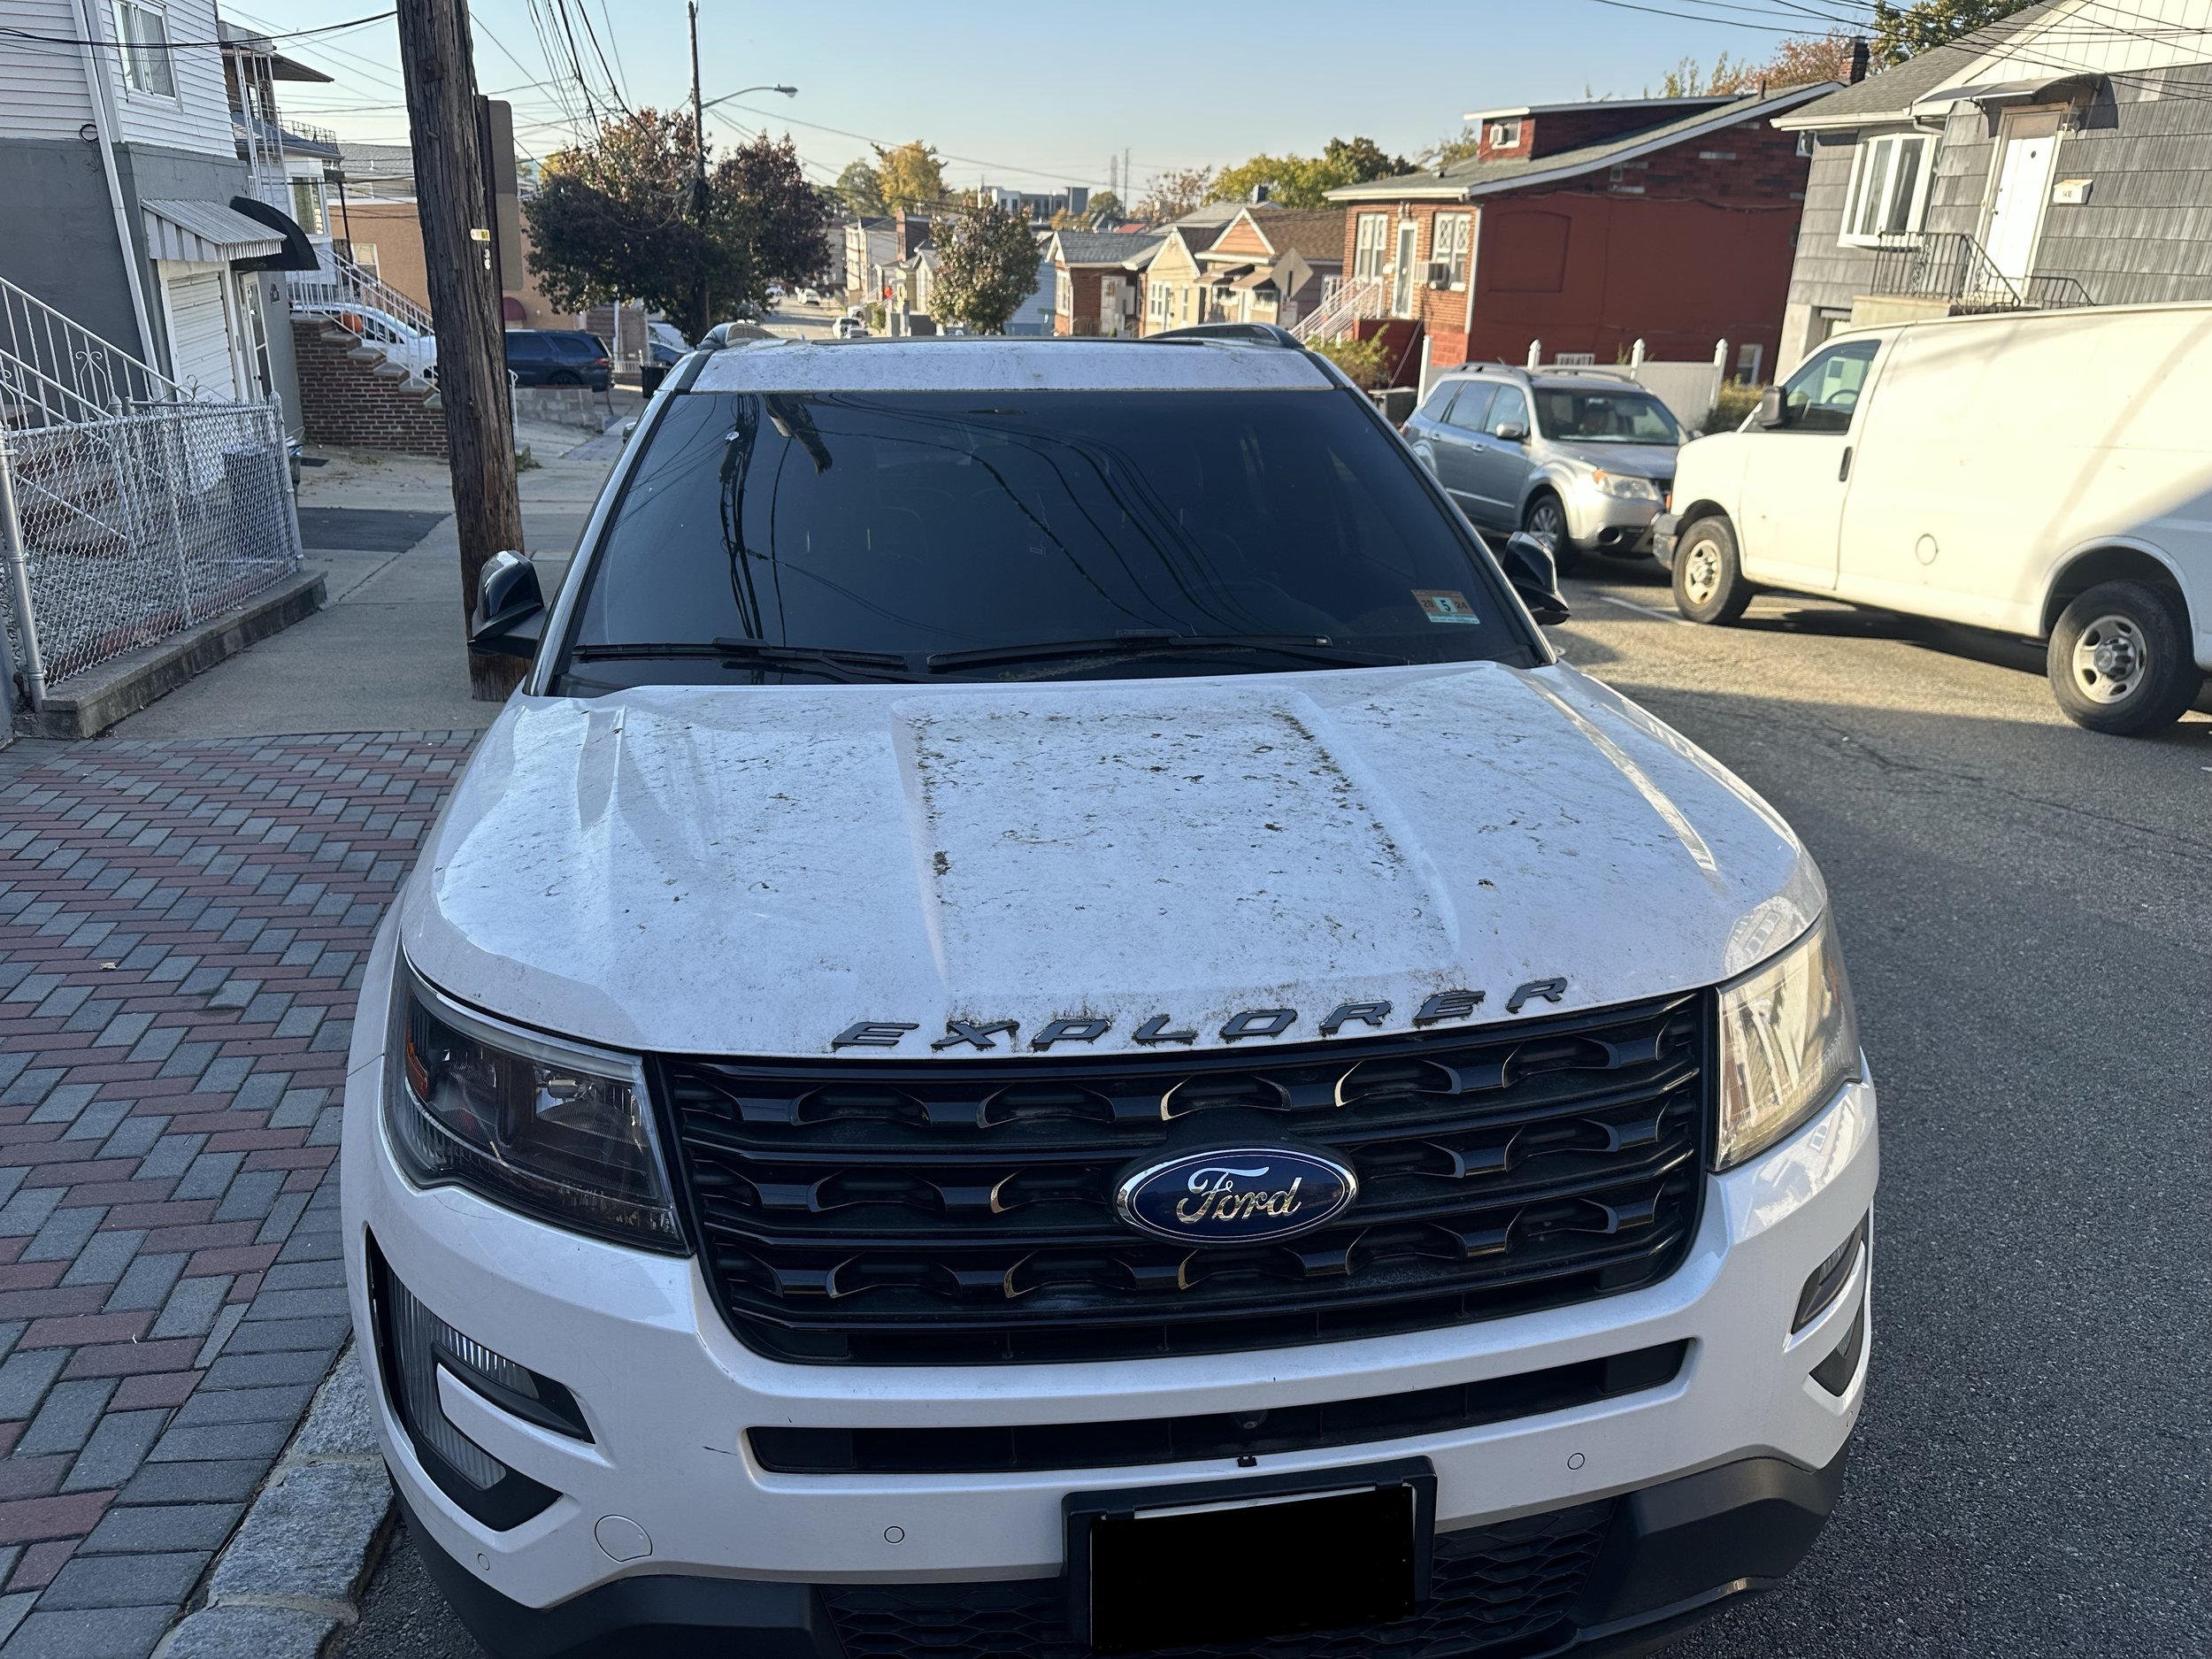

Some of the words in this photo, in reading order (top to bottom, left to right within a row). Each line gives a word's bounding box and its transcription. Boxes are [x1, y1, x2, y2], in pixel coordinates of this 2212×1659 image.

[1421, 599, 1435, 609] 20
[1440, 599, 1451, 612] 5
[1454, 601, 1469, 610] 24
[832, 976, 1568, 1051] EXPLORER
[1176, 1166, 1302, 1225] Ford
